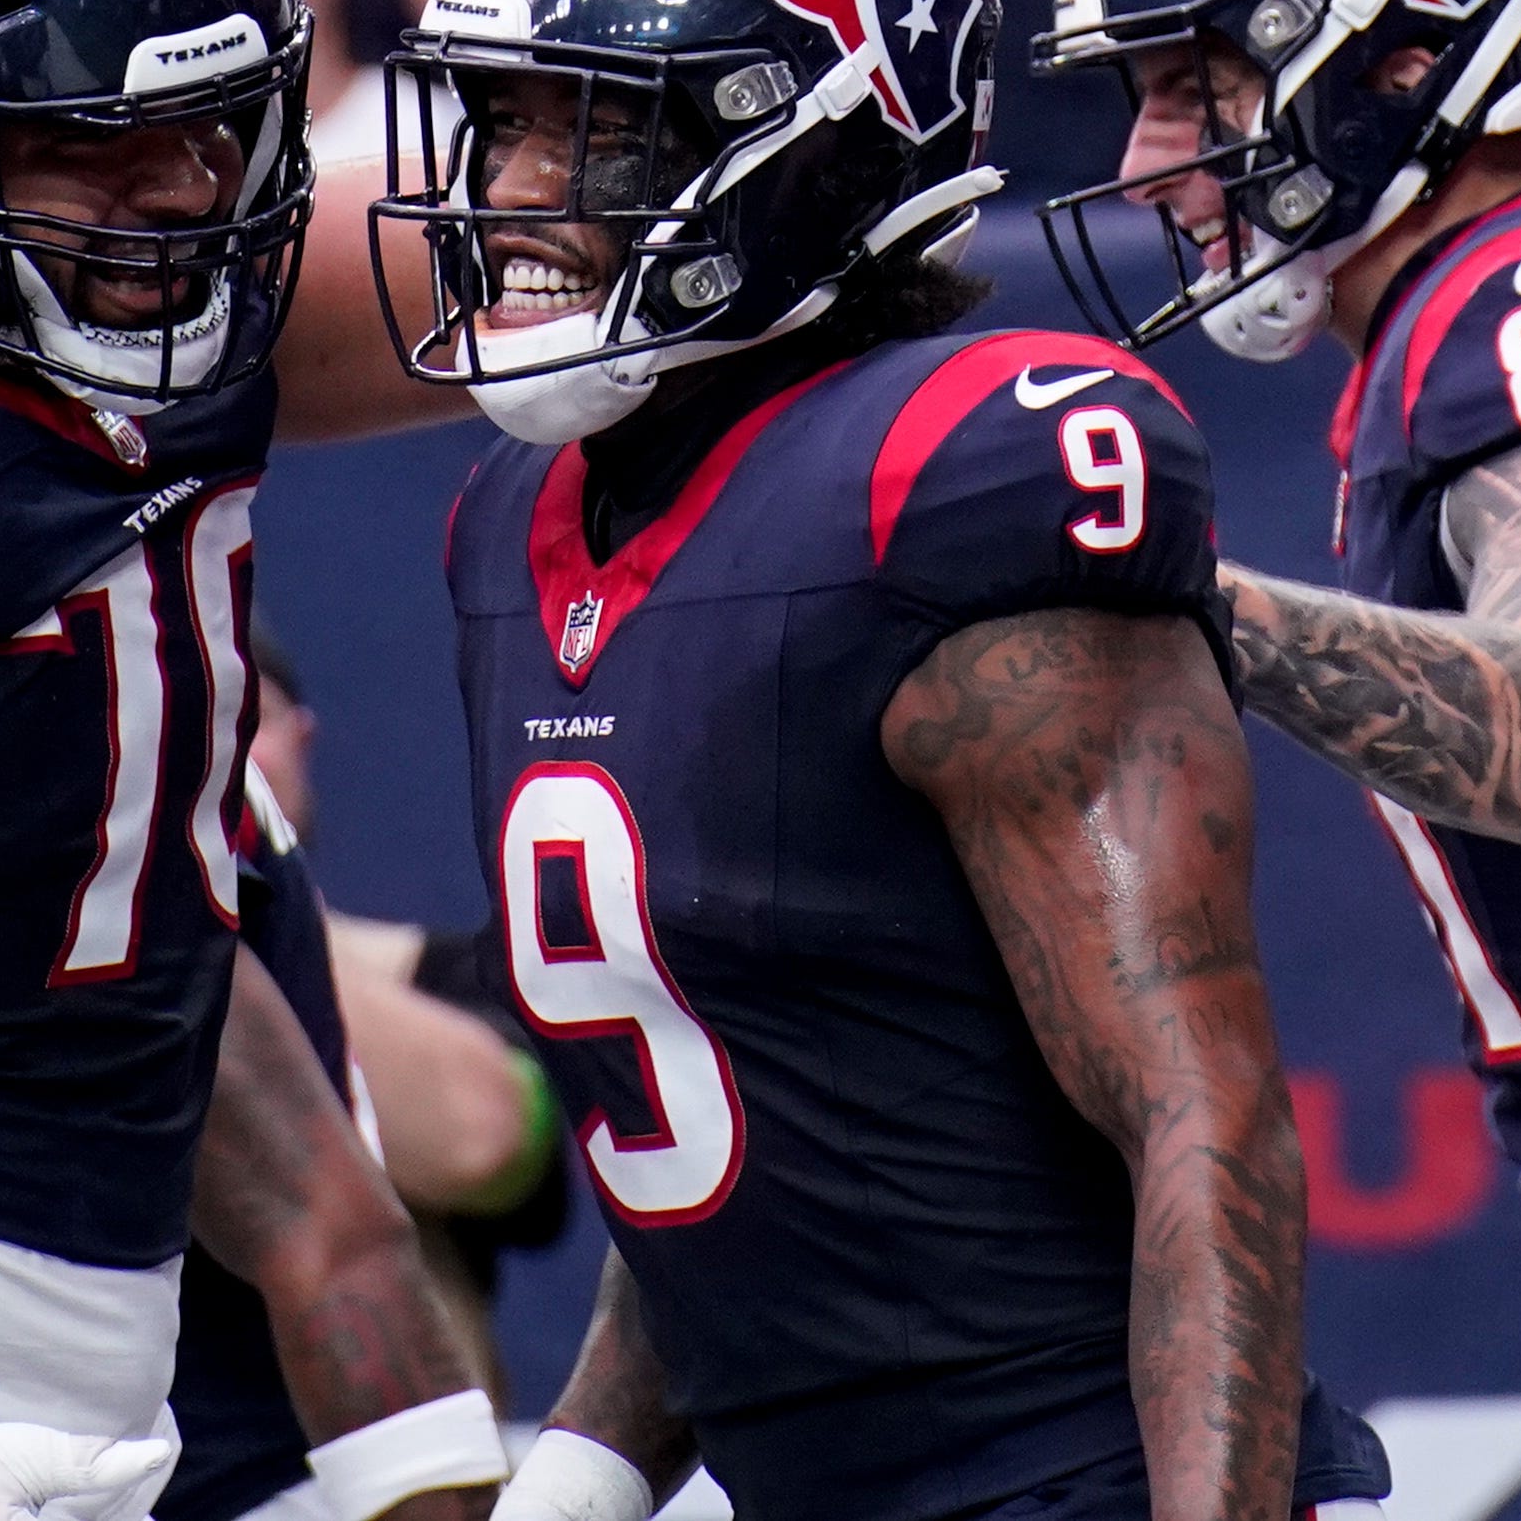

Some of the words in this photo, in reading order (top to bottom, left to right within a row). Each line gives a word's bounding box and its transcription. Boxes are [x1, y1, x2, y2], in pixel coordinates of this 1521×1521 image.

[436, 0, 500, 17] TEXANS
[155, 31, 247, 65] TEXANS
[1057, 403, 1149, 556] 9
[122, 476, 204, 534] TEXANS
[523, 715, 616, 741] TEXANS
[499, 760, 746, 1229] 9
